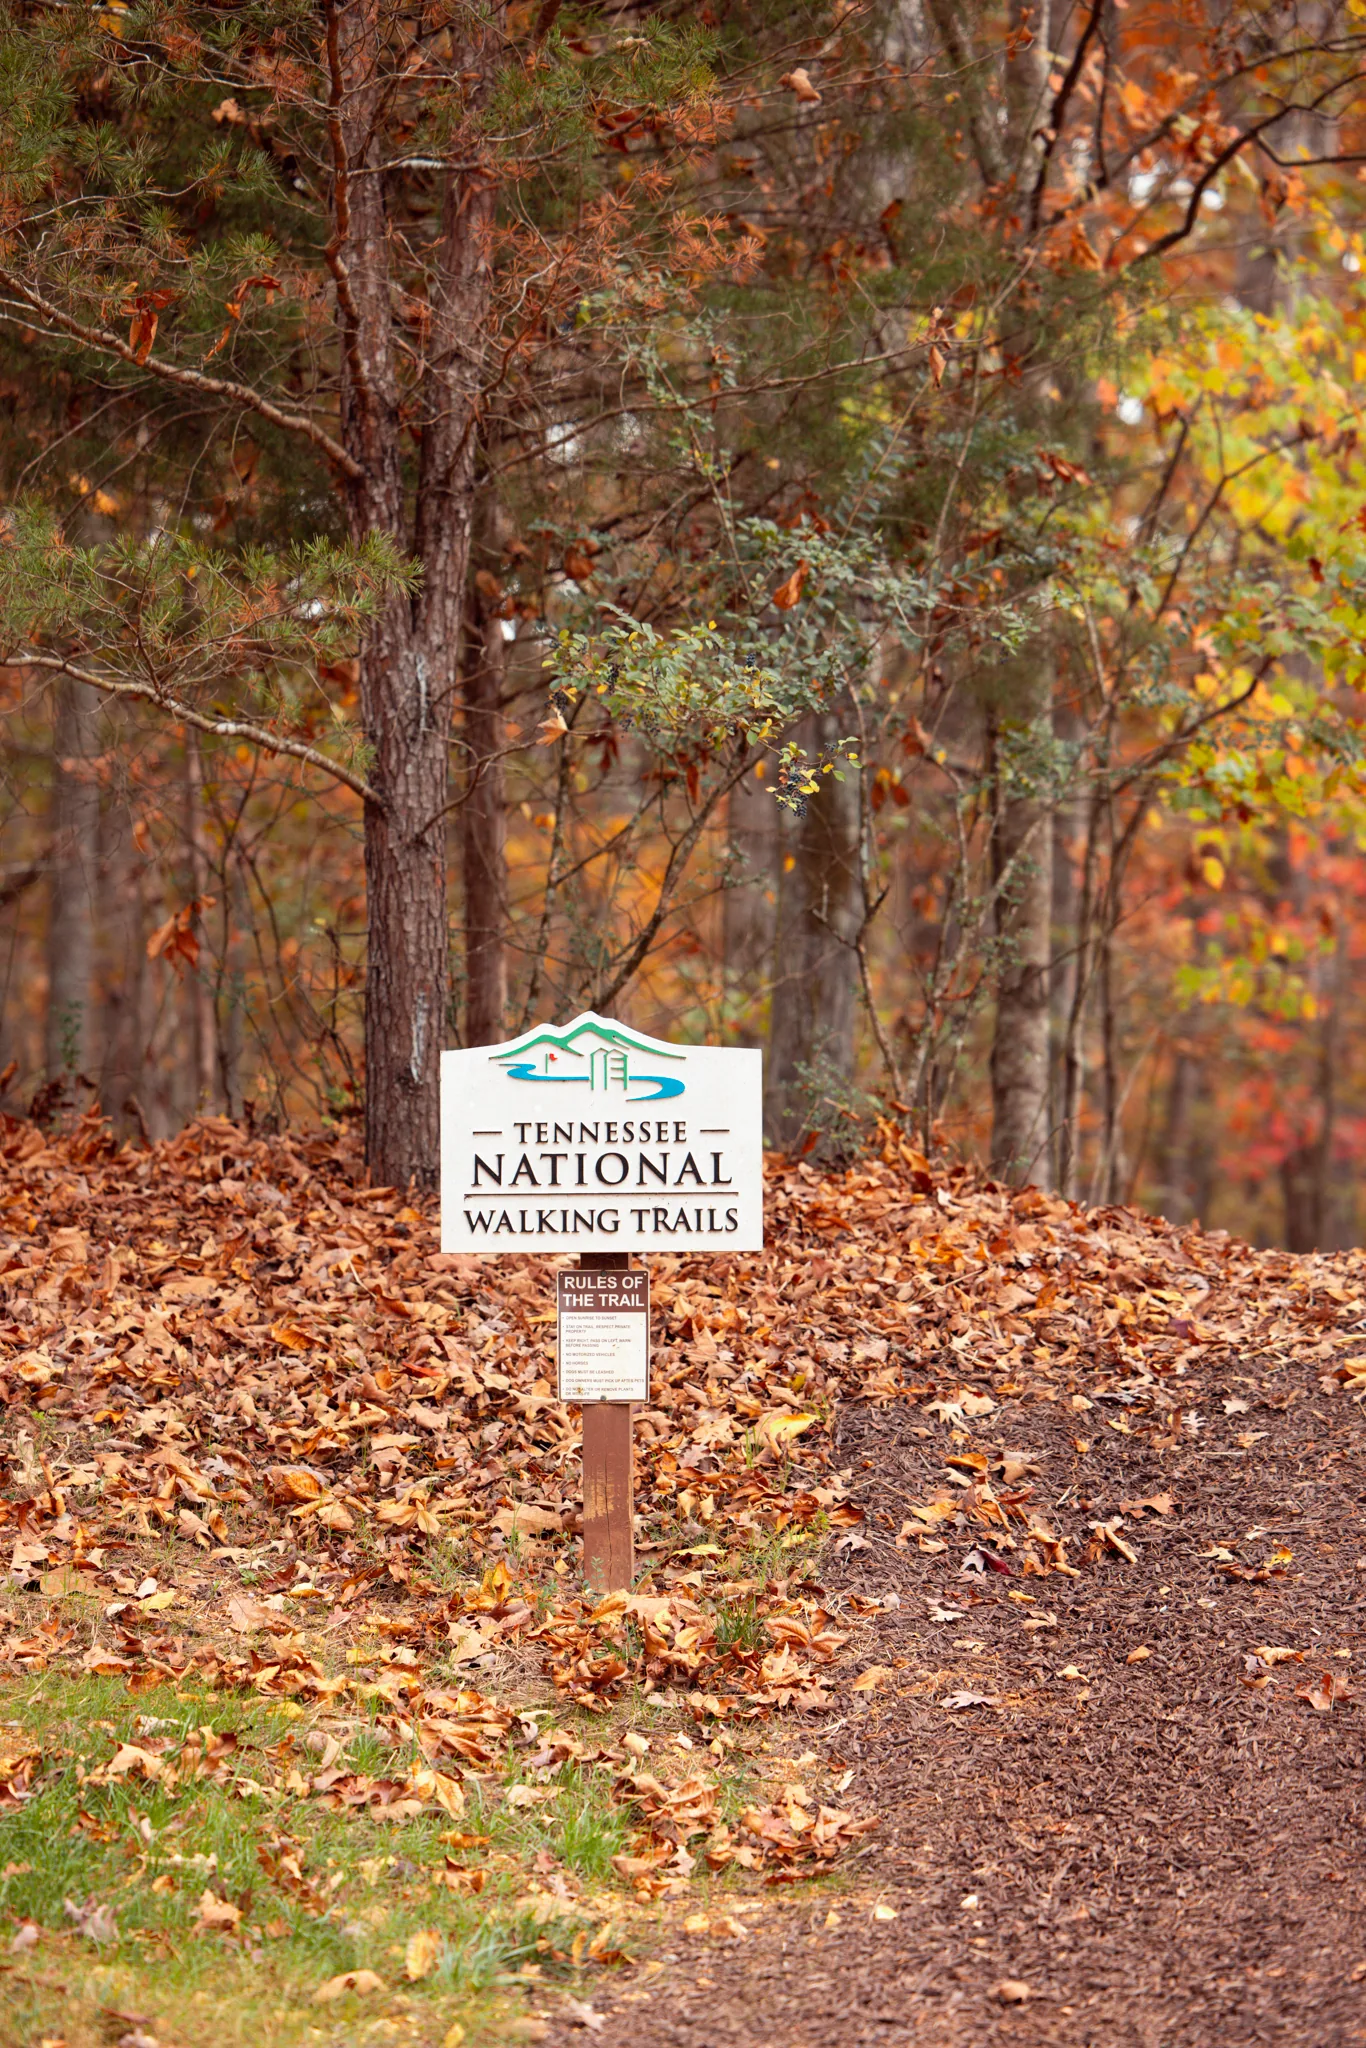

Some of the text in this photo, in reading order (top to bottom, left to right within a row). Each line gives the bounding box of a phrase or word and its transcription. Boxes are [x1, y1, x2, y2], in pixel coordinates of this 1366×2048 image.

[513, 1121, 687, 1144] TENNESSEE
[470, 1151, 733, 1187] NATIONAL
[463, 1207, 739, 1235] WALKING TRAILS
[564, 1276, 644, 1289] RULES OF
[562, 1294, 644, 1306] THE TRAIL
